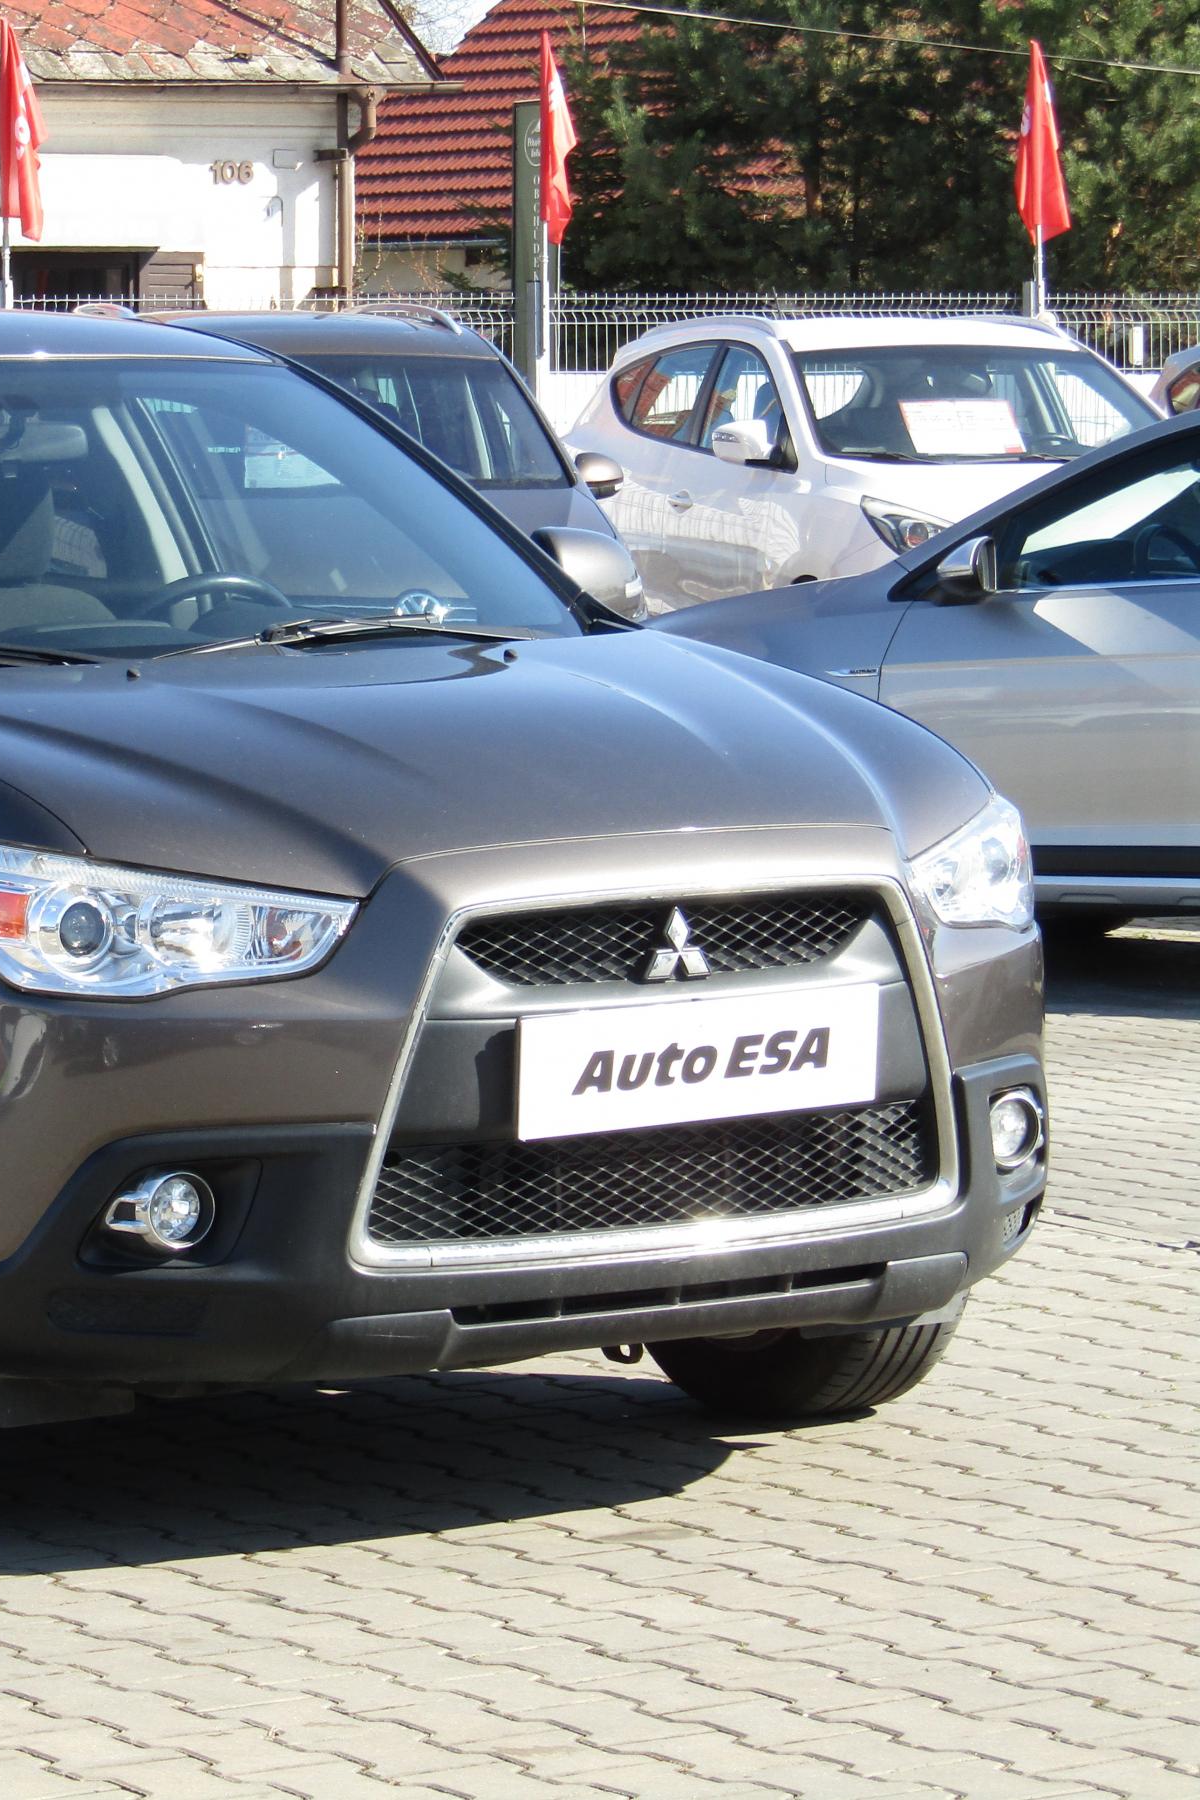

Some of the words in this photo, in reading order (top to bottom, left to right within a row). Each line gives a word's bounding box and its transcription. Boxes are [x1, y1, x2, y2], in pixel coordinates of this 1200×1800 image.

[209, 160, 254, 185] 106
[571, 1042, 718, 1096] Auto
[723, 1027, 831, 1079] ESA
